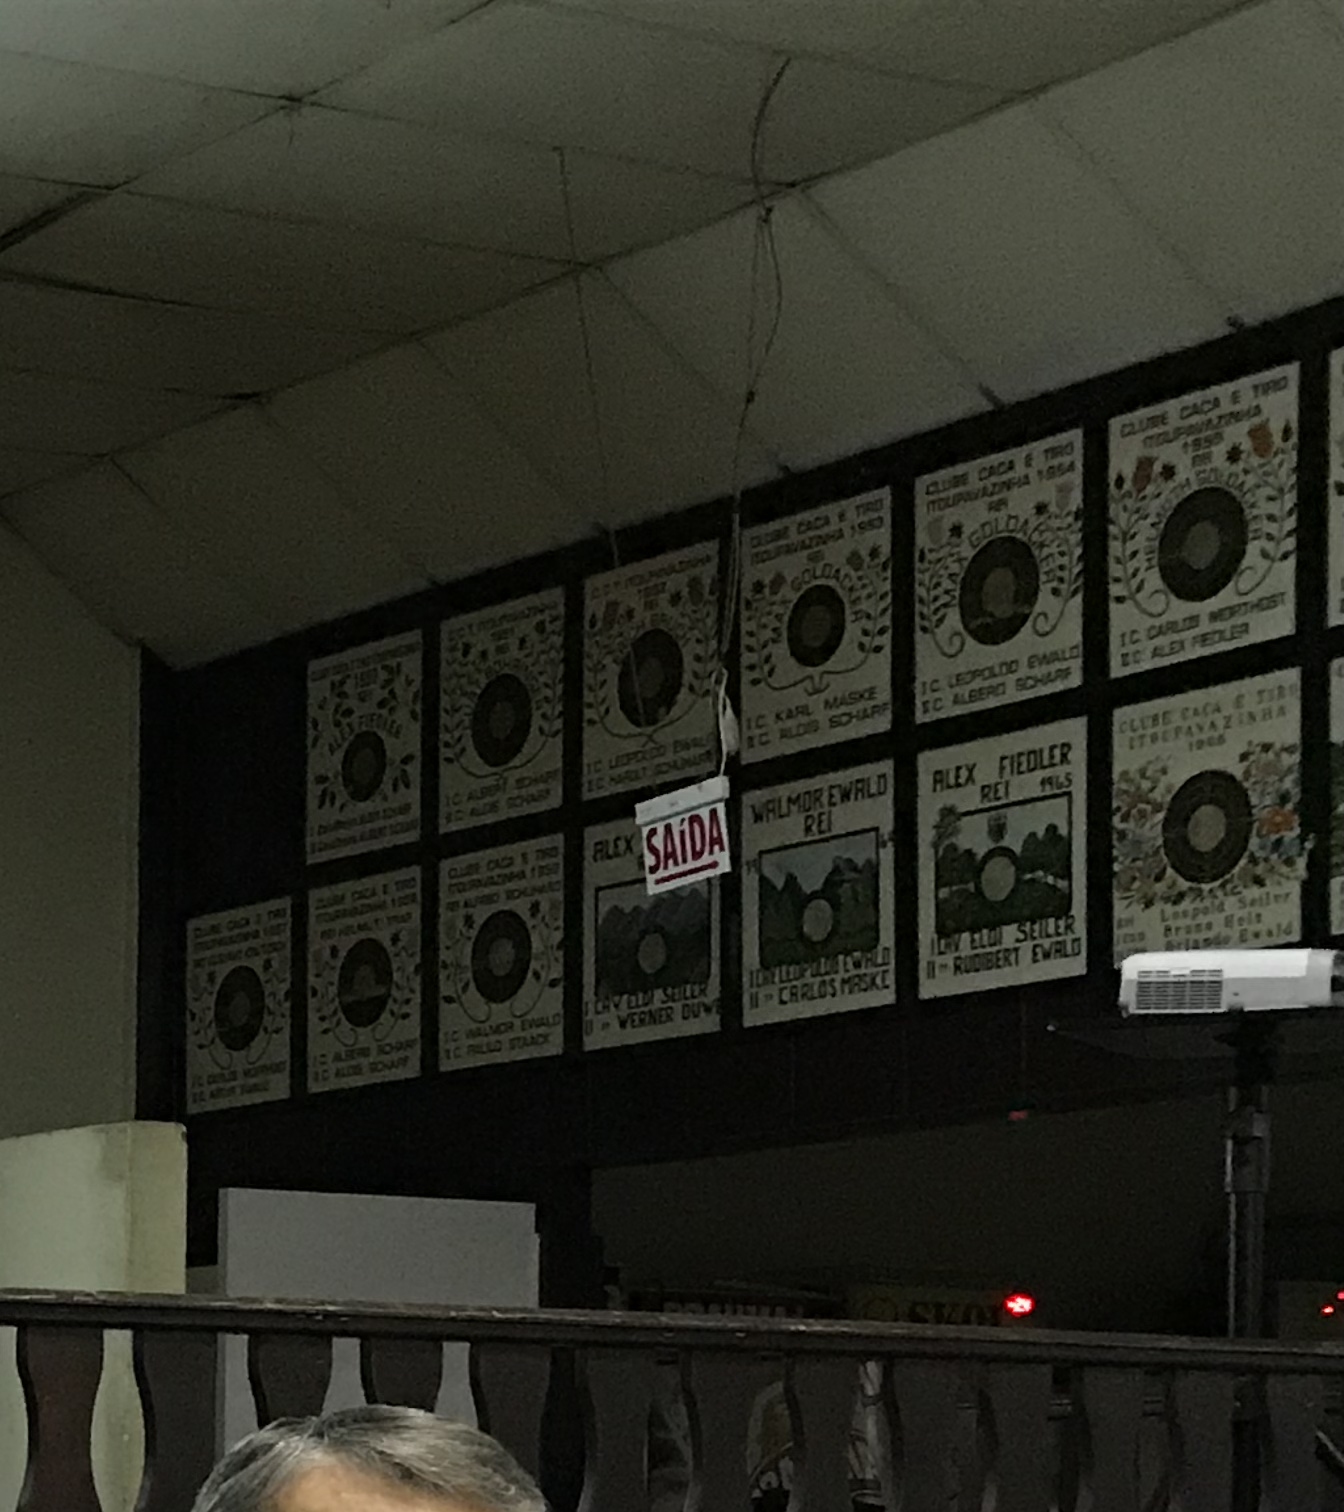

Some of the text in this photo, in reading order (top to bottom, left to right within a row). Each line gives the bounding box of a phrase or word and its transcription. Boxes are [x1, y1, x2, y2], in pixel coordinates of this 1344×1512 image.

[932, 742, 1073, 793] ALEX FIEDLER
[827, 773, 887, 807] EWALD
[980, 780, 1010, 803] REI
[804, 810, 832, 837] REI
[592, 833, 635, 863] ALEX
[1015, 915, 1076, 943] SEILER
[1031, 937, 1082, 964] EWALD
[617, 1006, 674, 1030] WERNER
